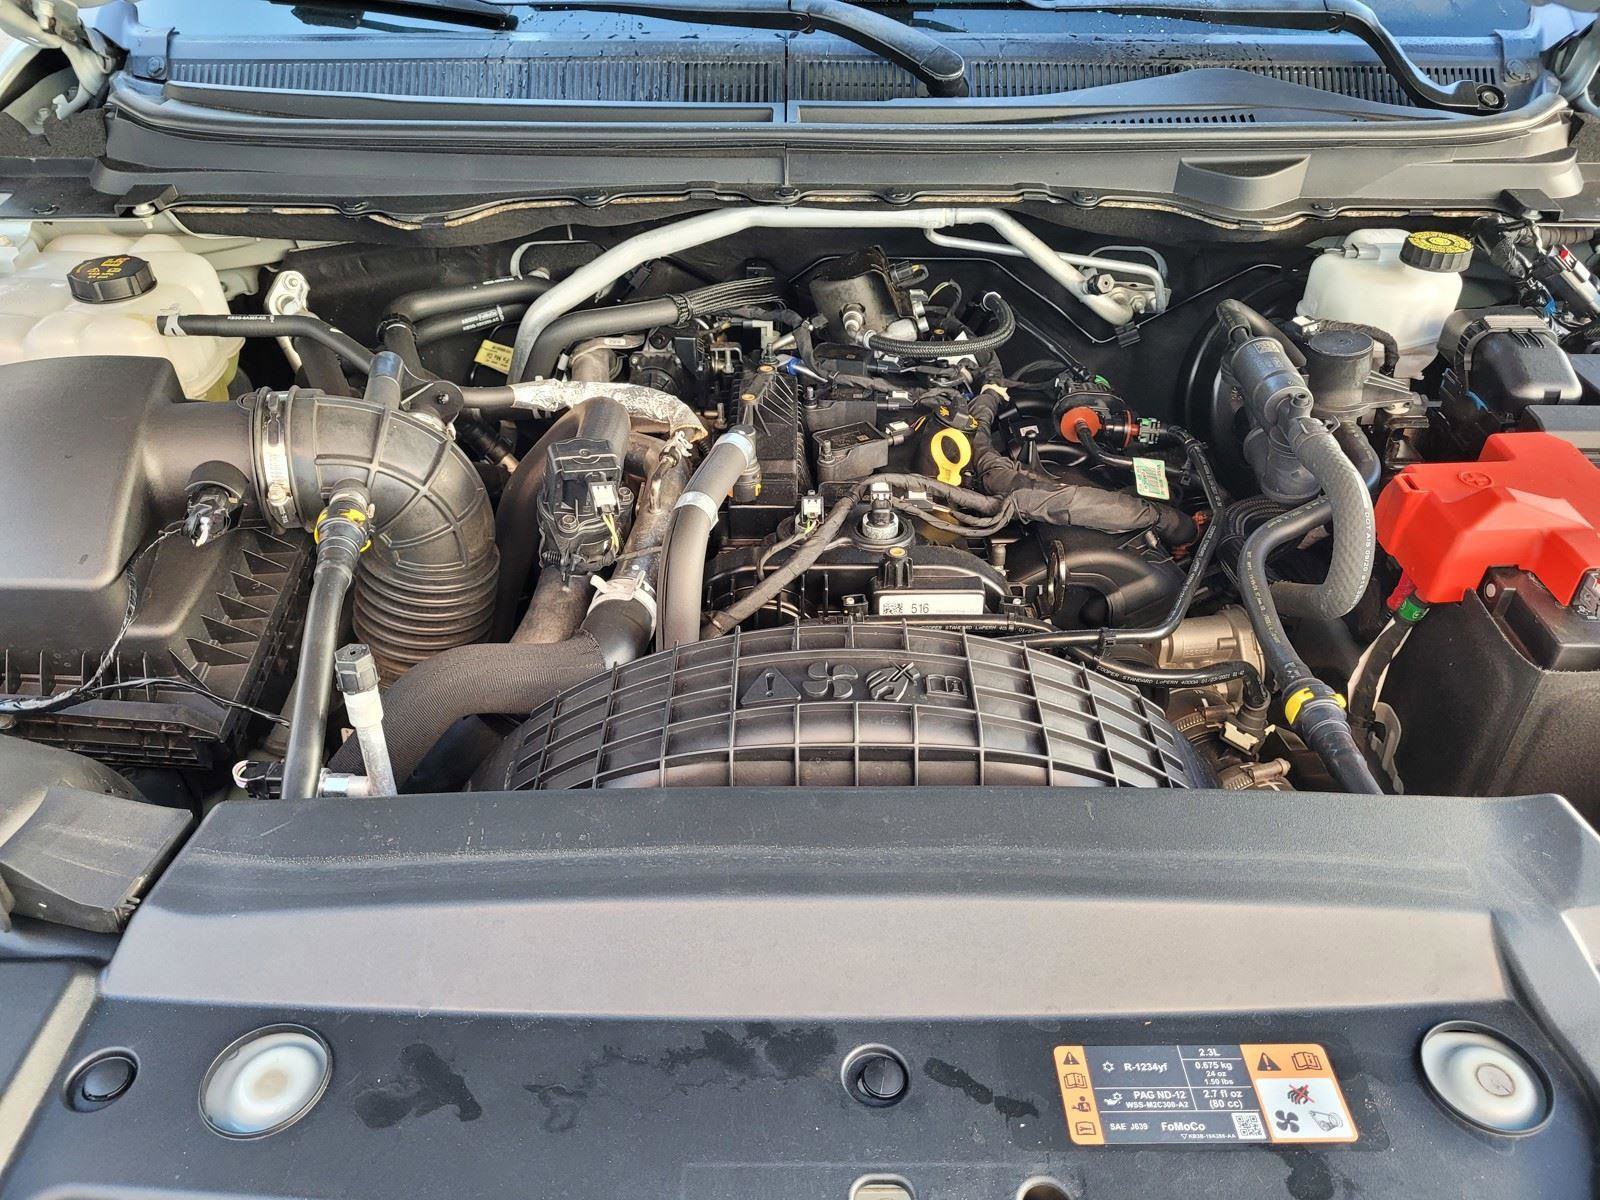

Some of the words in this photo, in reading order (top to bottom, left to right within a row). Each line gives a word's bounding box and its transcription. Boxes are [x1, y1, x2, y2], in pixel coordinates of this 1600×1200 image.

[911, 603, 930, 614] 516
[1096, 665, 1120, 678] COOPER
[1122, 675, 1154, 684] STANDARD
[1198, 1048, 1221, 1057] 2.3L
[1123, 1062, 1168, 1074] R-1234yf
[1194, 1062, 1219, 1070] 0.675
[1220, 1062, 1233, 1071] kg
[1133, 1091, 1155, 1100] PAG
[1157, 1091, 1187, 1100] ND-12
[1202, 1090, 1217, 1098] 2.7
[1209, 1099, 1225, 1109] (80
[1227, 1099, 1243, 1109] cc)
[1110, 1122, 1127, 1131] SAE
[1130, 1122, 1149, 1131] J639
[1161, 1121, 1206, 1132] FoMoCo
